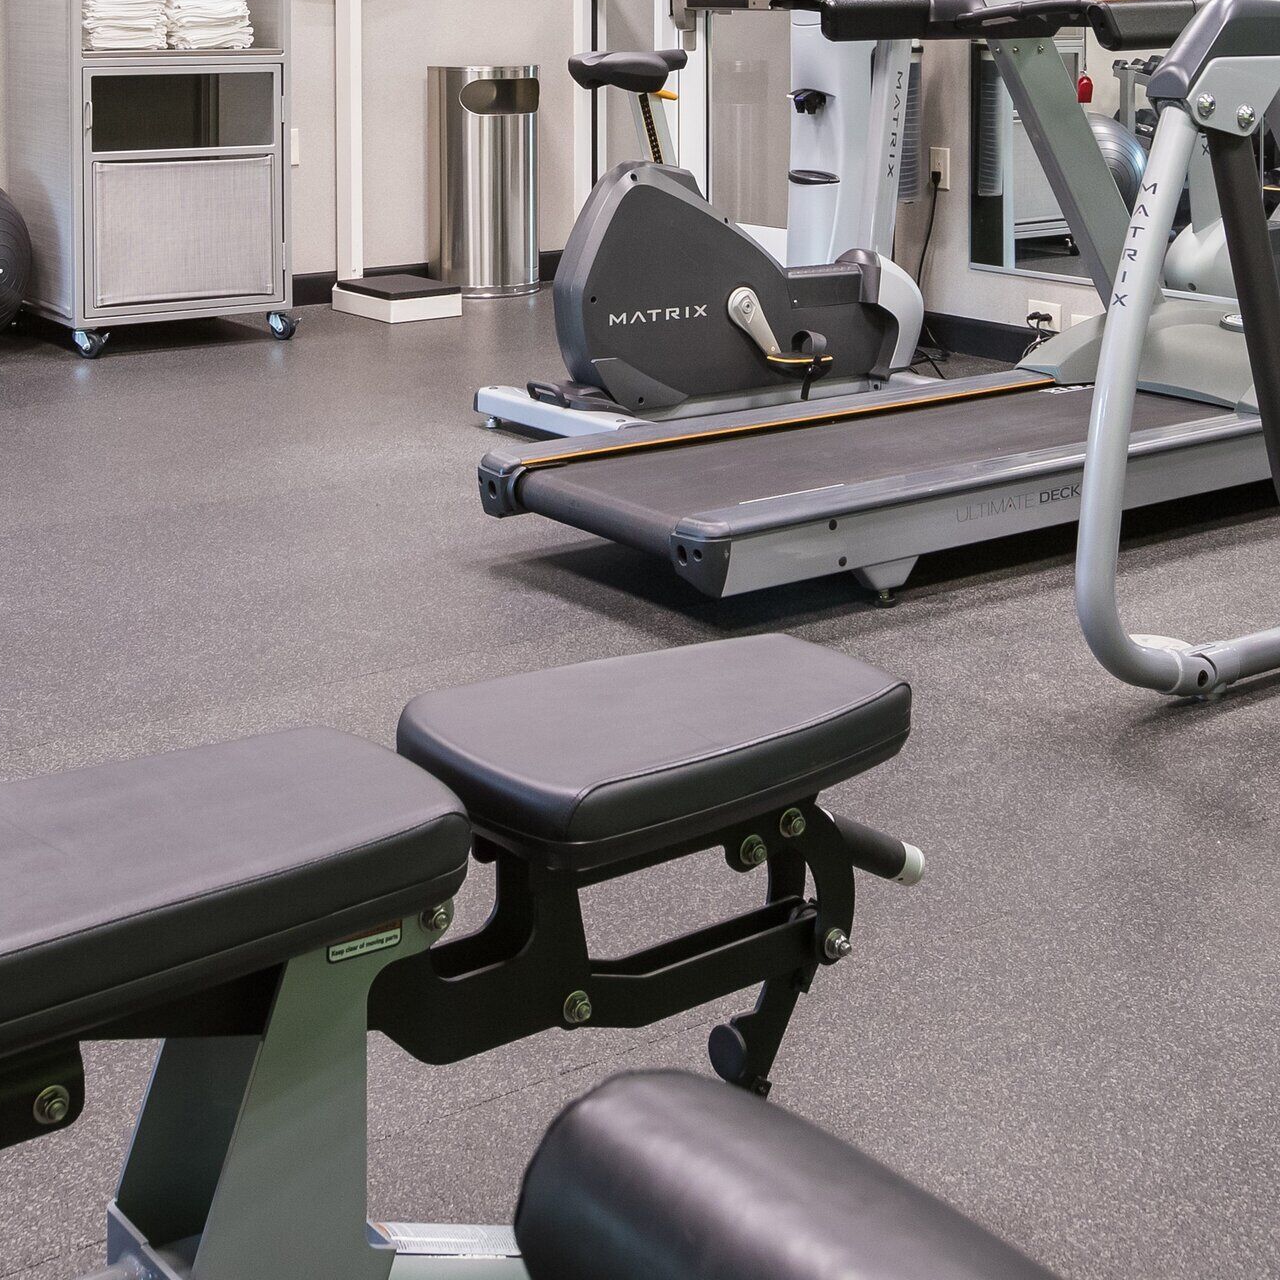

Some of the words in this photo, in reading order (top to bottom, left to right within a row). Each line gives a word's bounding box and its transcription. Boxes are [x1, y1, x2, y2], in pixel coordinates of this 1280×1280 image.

[887, 71, 903, 177] MATRIX
[1112, 183, 1158, 307] MATRIX
[609, 304, 707, 326] MATRIX
[956, 492, 1035, 523] ULTIMATE
[1039, 485, 1080, 503] DECK
